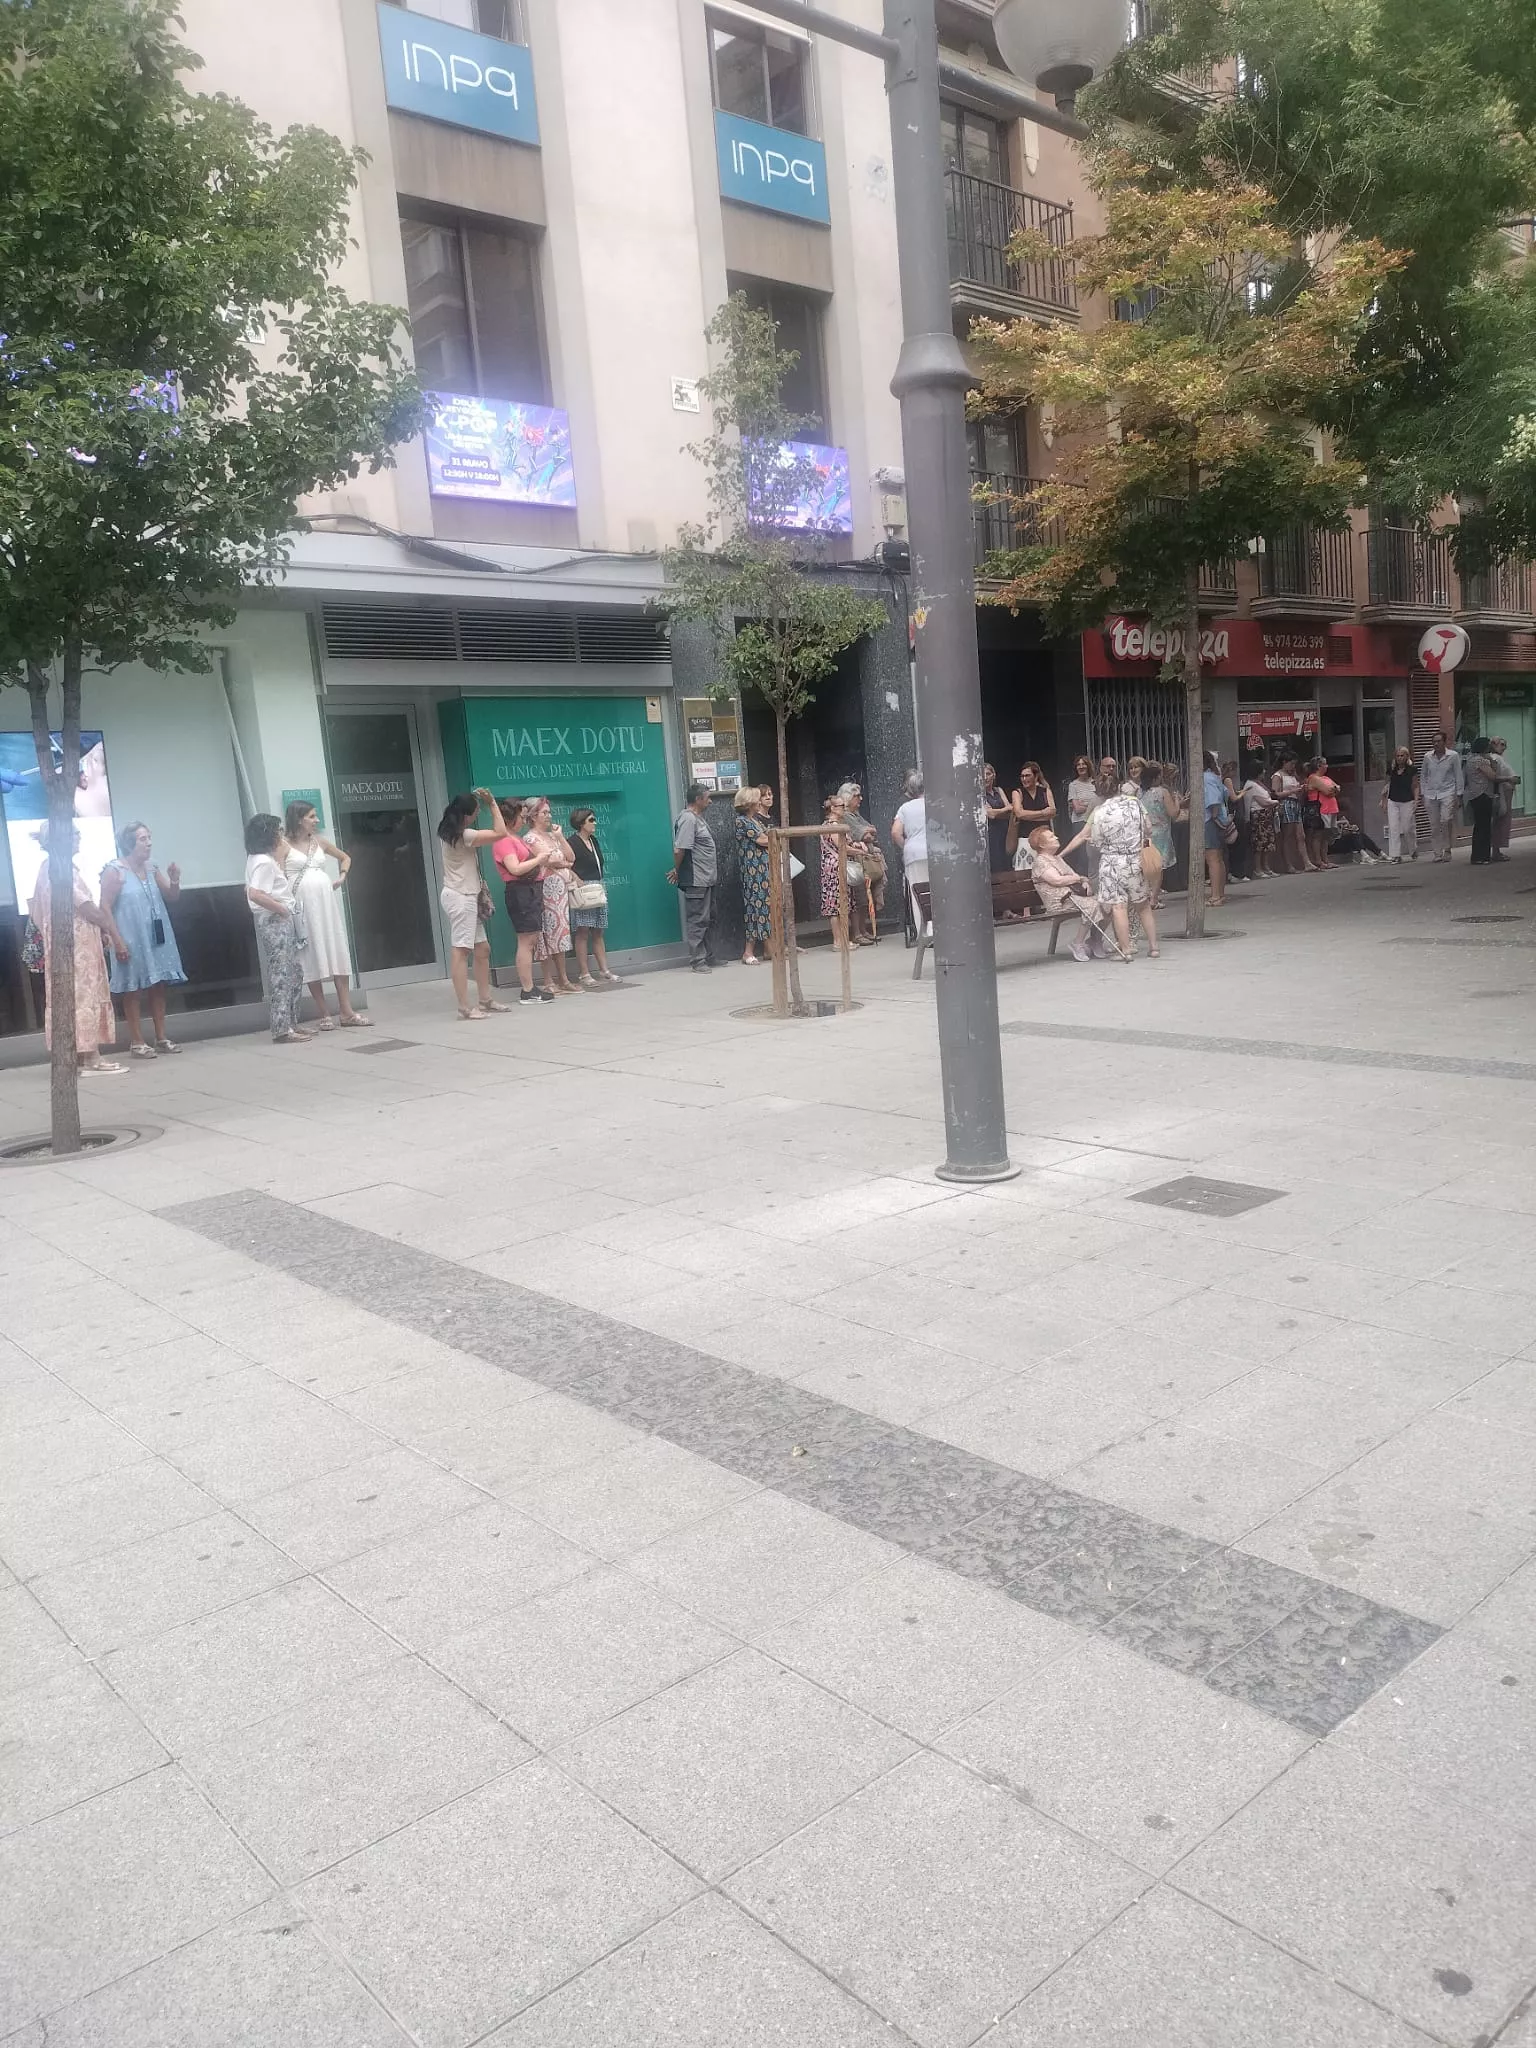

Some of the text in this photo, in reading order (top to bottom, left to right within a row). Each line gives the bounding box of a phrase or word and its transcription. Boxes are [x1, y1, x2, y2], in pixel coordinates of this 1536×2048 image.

[1275, 634, 1324, 649] 974 226 399
[1263, 651, 1325, 674] telepizza.es
[492, 726, 645, 757] MAEX DOTU
[497, 760, 648, 780] CLÍNICA DENTAL INTEGRAL
[341, 781, 403, 794] MAEX DOTU
